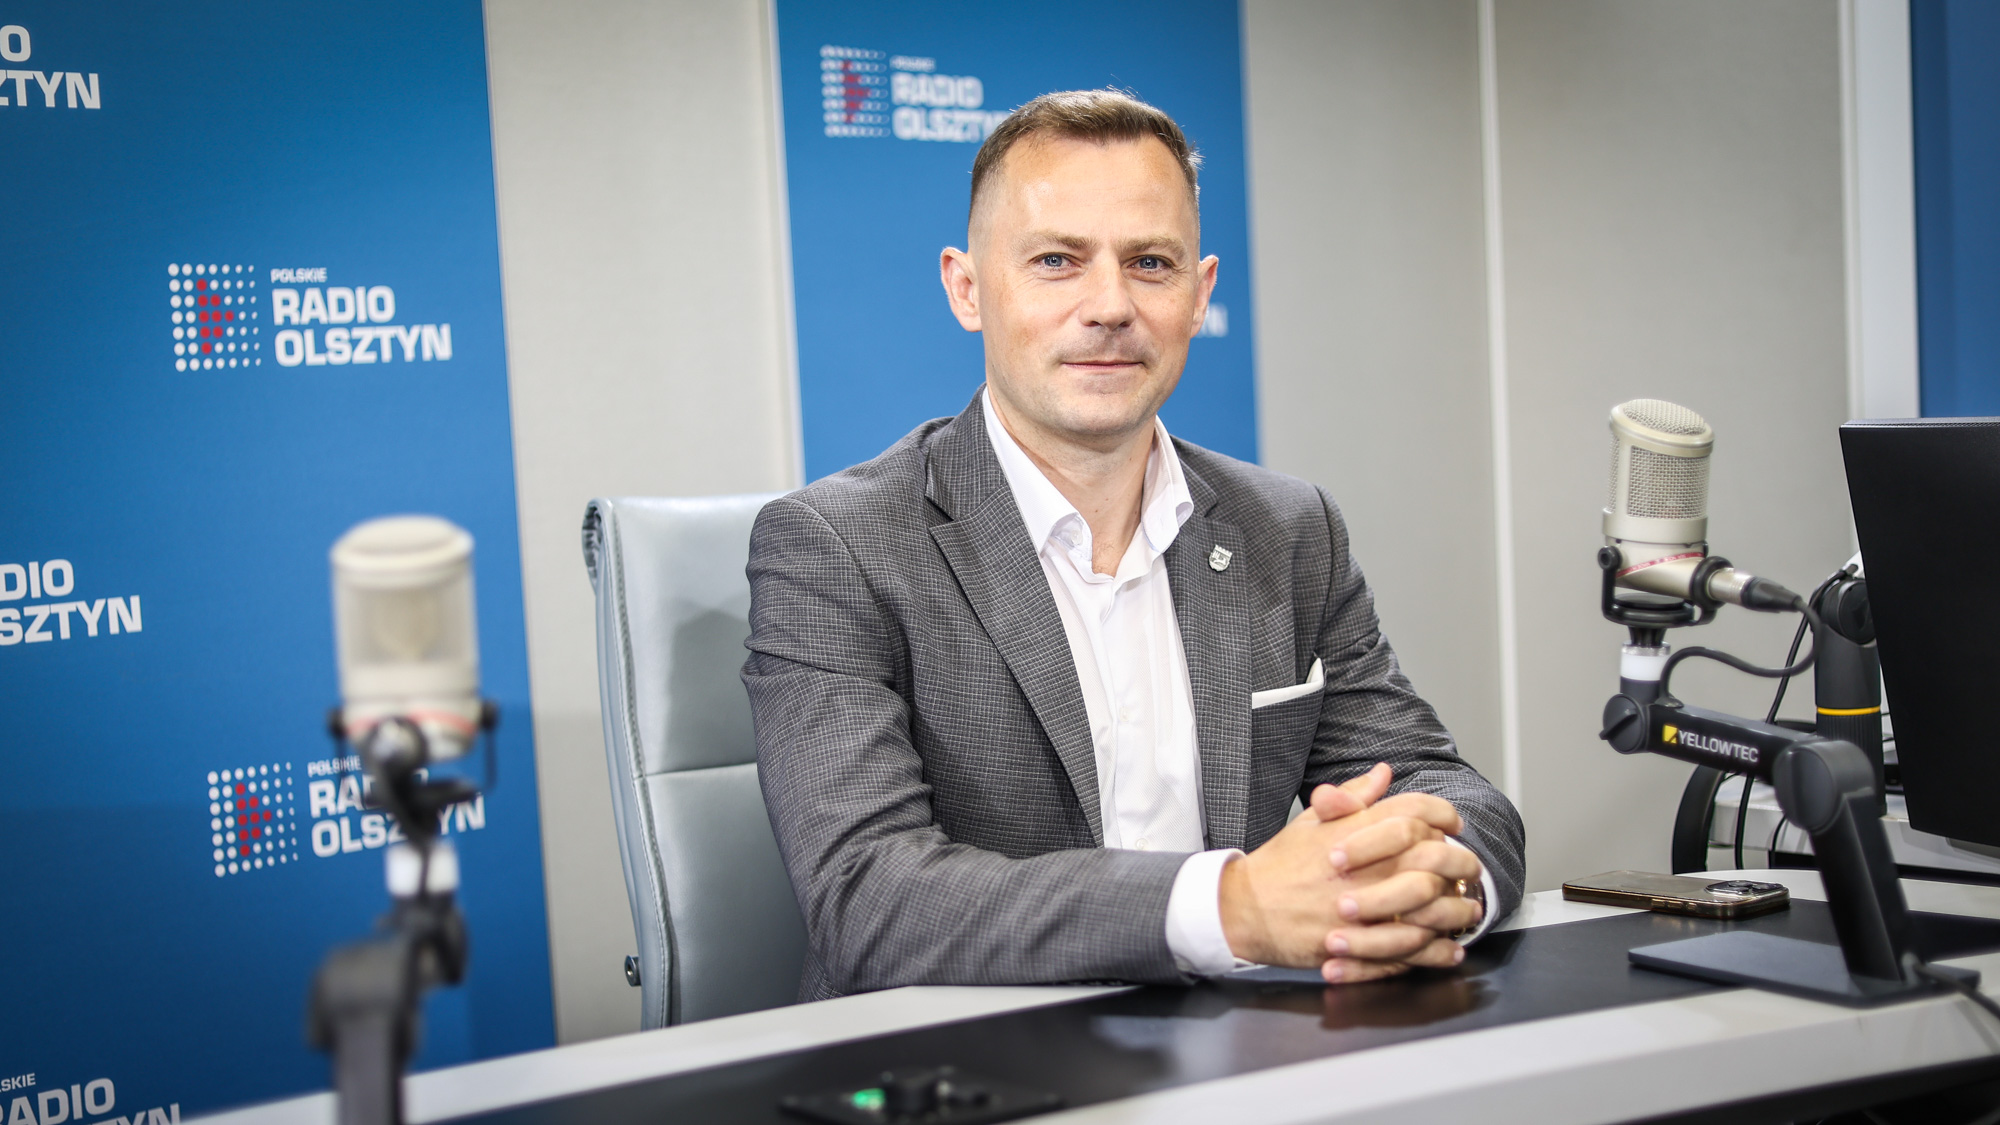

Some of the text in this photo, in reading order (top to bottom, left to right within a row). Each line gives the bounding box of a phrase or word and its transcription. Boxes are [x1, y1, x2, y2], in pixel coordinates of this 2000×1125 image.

[270, 267, 328, 283] POLSKIE
[272, 285, 396, 326] RADIO
[274, 323, 452, 367] OLSZTYN
[0, 594, 143, 646] SZTYN
[1678, 729, 1759, 763] YELLOWTEC
[311, 791, 486, 858] OLSZYN
[0, 1072, 36, 1093] SKIE
[0, 1077, 116, 1125] ADIO
